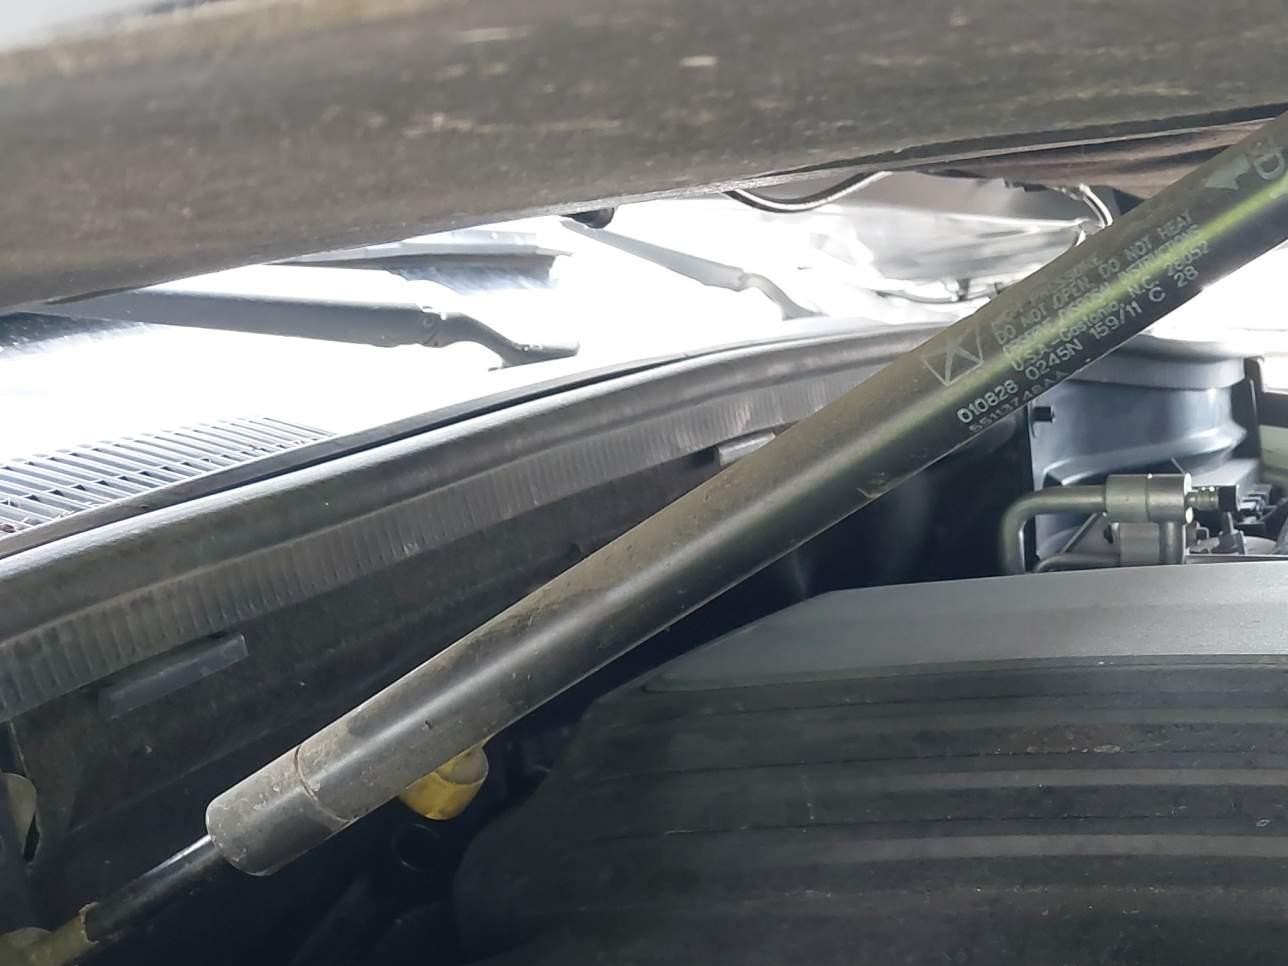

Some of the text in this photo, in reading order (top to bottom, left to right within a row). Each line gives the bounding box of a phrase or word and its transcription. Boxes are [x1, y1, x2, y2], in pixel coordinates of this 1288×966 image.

[1124, 234, 1153, 261] NOT
[957, 379, 1018, 423] 010828
[1025, 338, 1083, 380] 0245N
[1089, 301, 1142, 339] 159/11
[1173, 265, 1199, 287] 28
